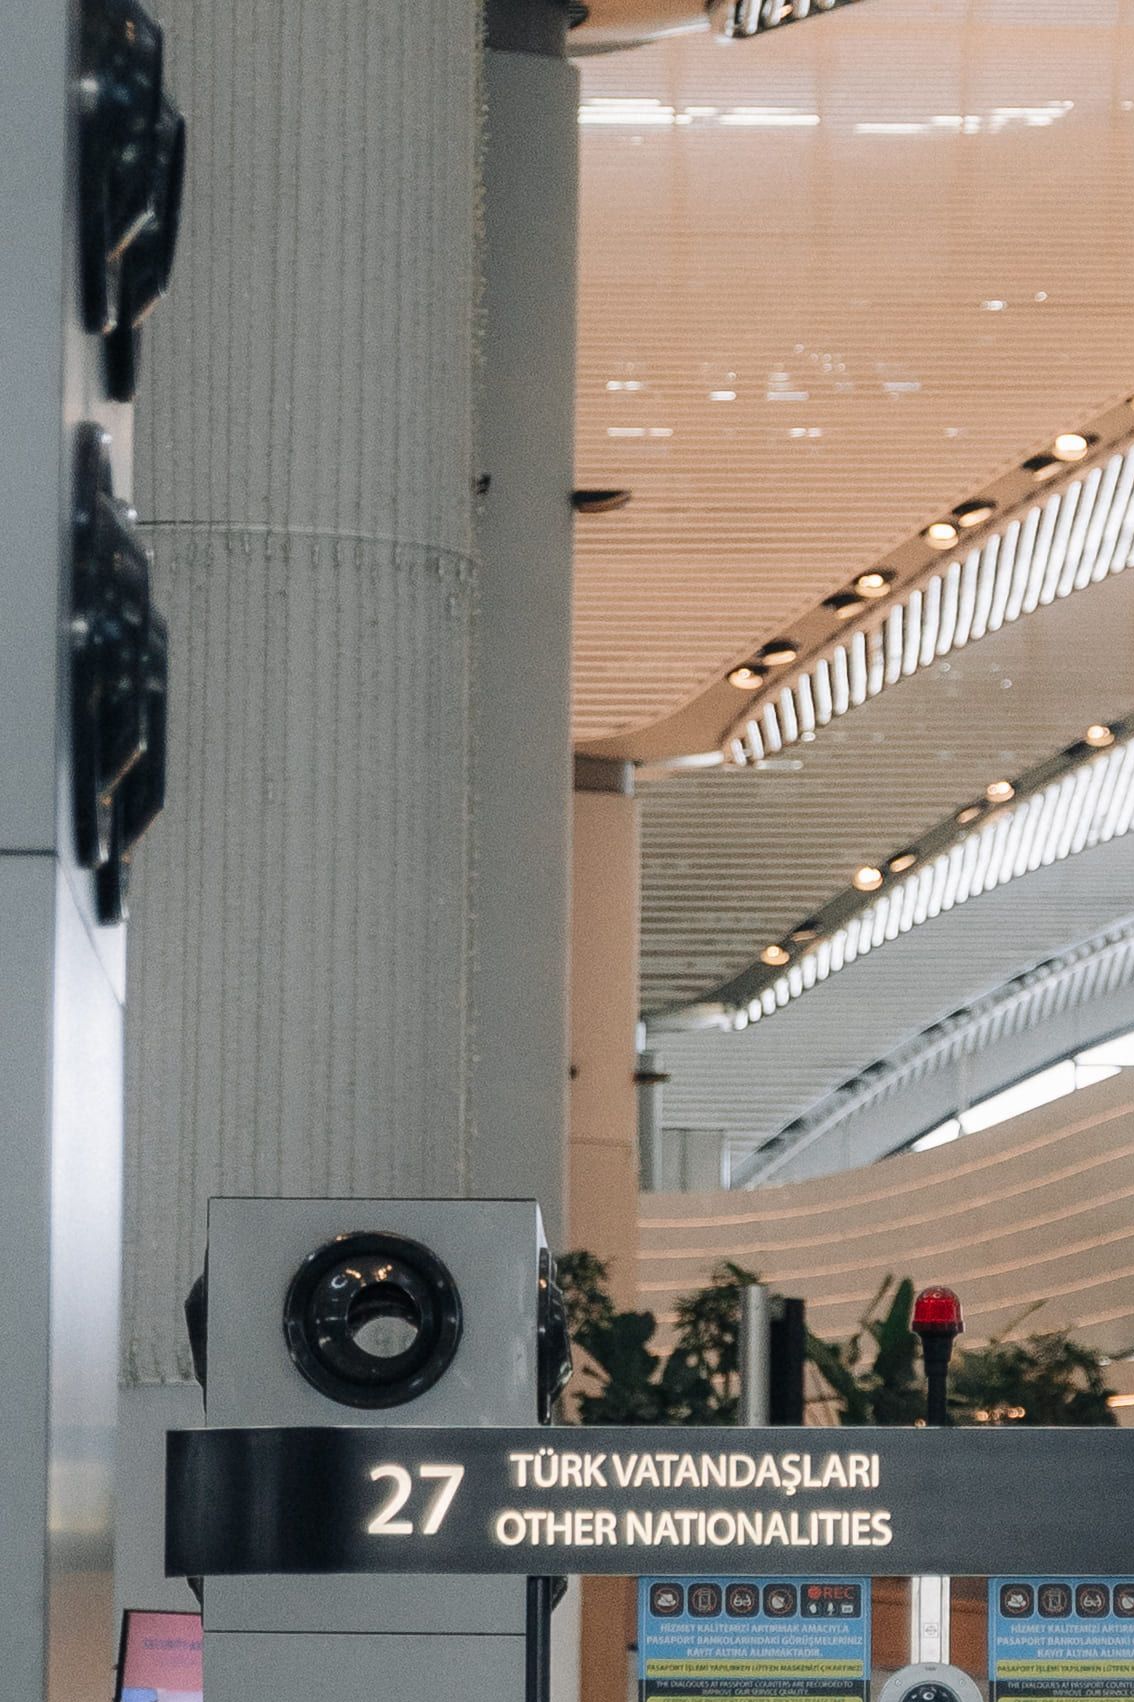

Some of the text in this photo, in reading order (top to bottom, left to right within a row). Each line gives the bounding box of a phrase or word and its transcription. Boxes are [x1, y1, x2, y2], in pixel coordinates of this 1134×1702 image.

[510, 1448, 880, 1496] TÜRK VATANDAŞLARI
[368, 1464, 465, 1535] 27
[498, 1511, 893, 1546] OTHER NATIONALITIES
[822, 1586, 855, 1600] REC
[646, 1634, 695, 1646] PASAPORT
[997, 1635, 1045, 1647] PASAPORT
